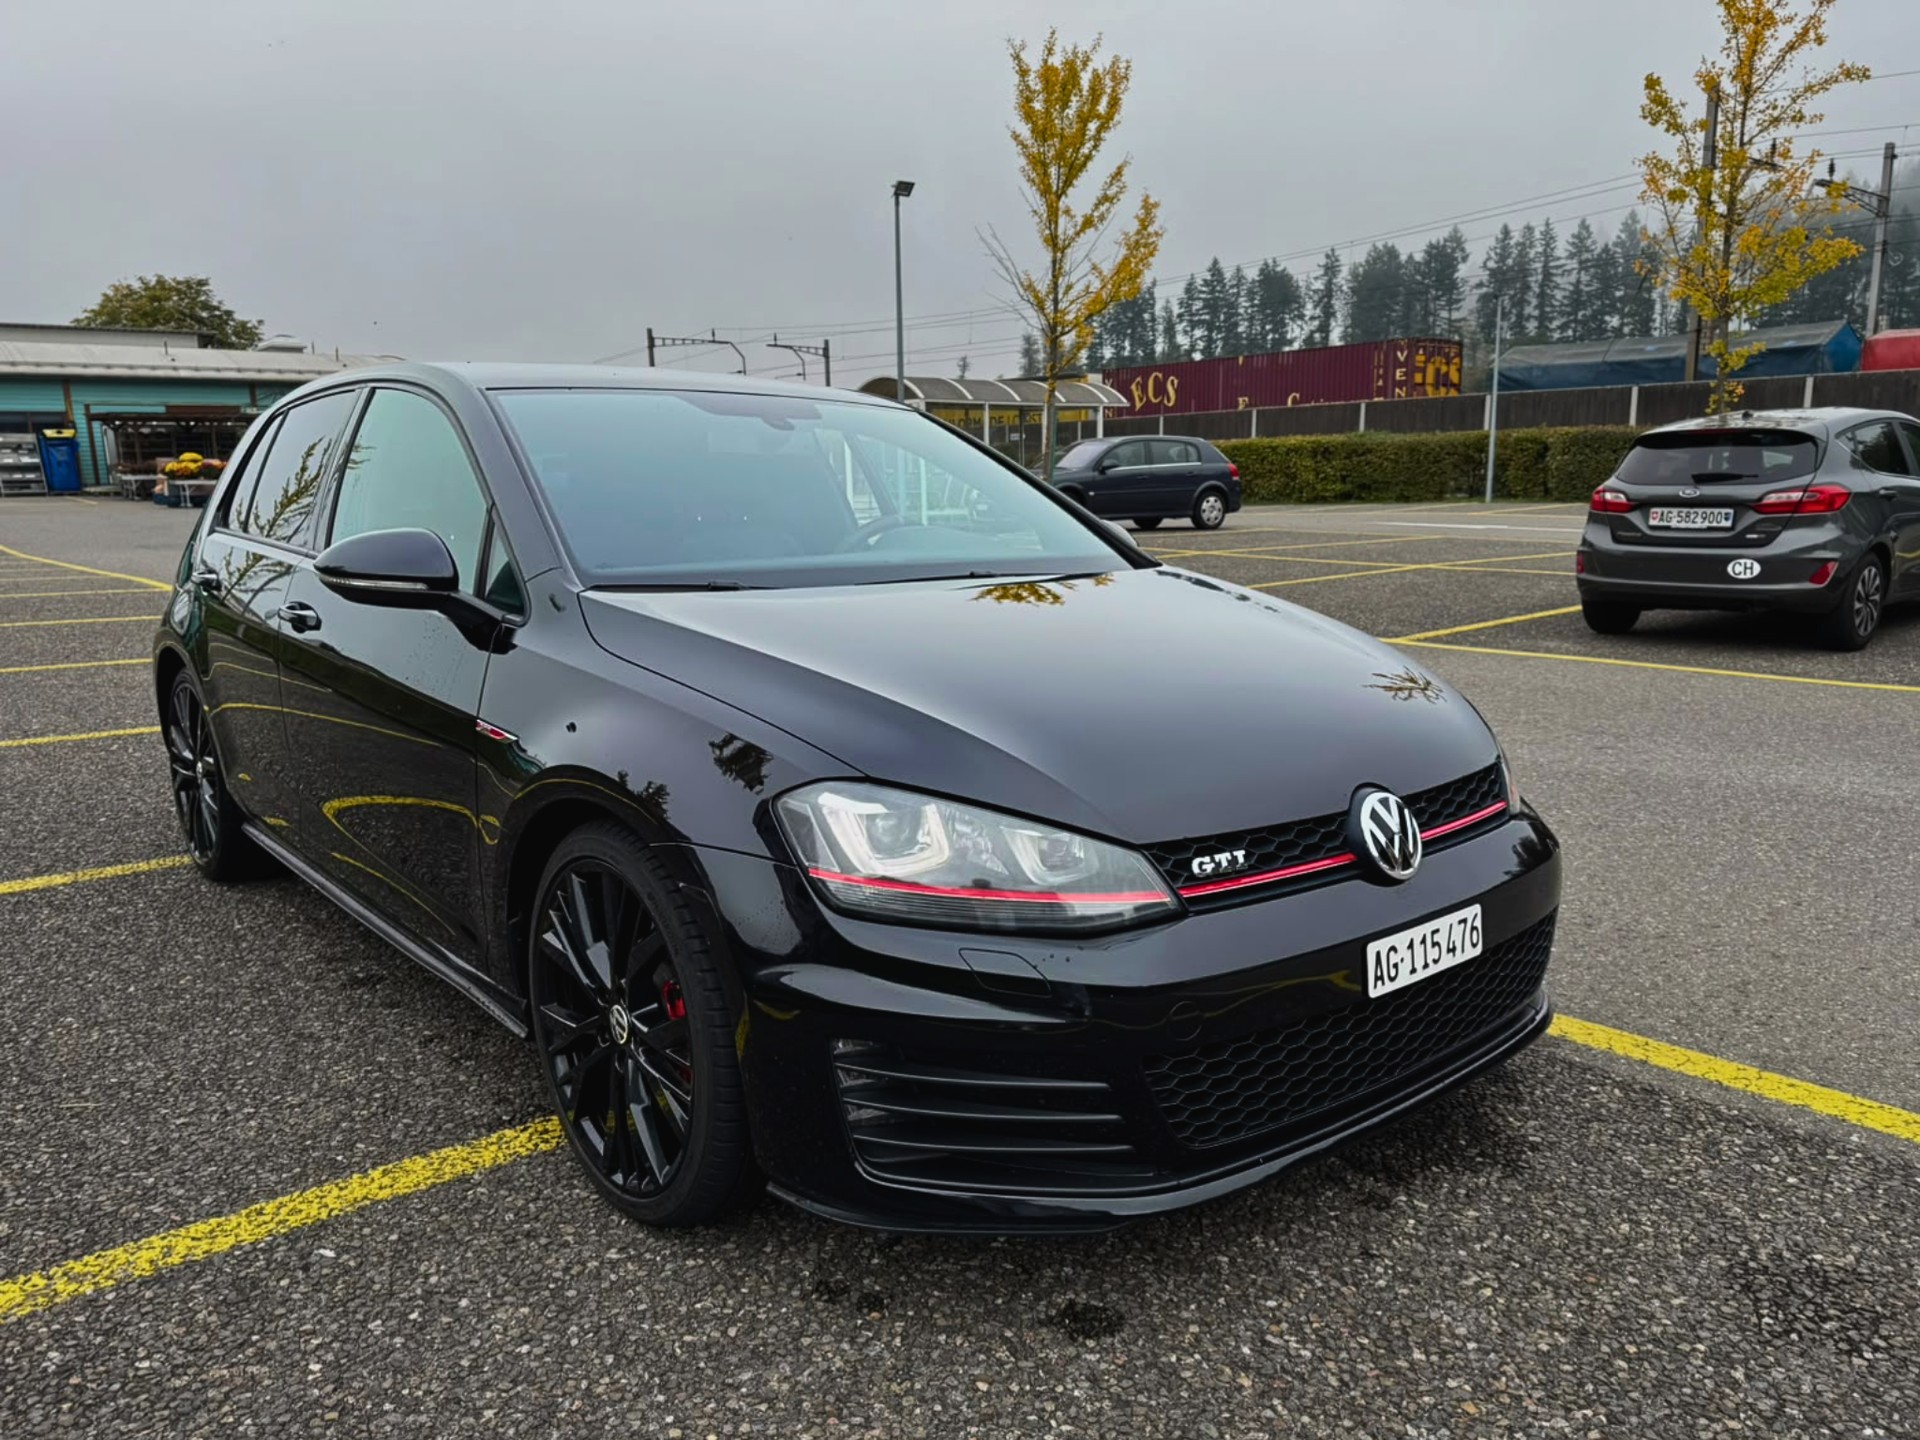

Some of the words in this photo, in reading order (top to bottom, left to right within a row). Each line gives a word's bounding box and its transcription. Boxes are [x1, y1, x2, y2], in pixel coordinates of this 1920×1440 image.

[1130, 371, 1178, 412] ECS
[1731, 560, 1755, 577] CH
[1191, 849, 1247, 877] GTI
